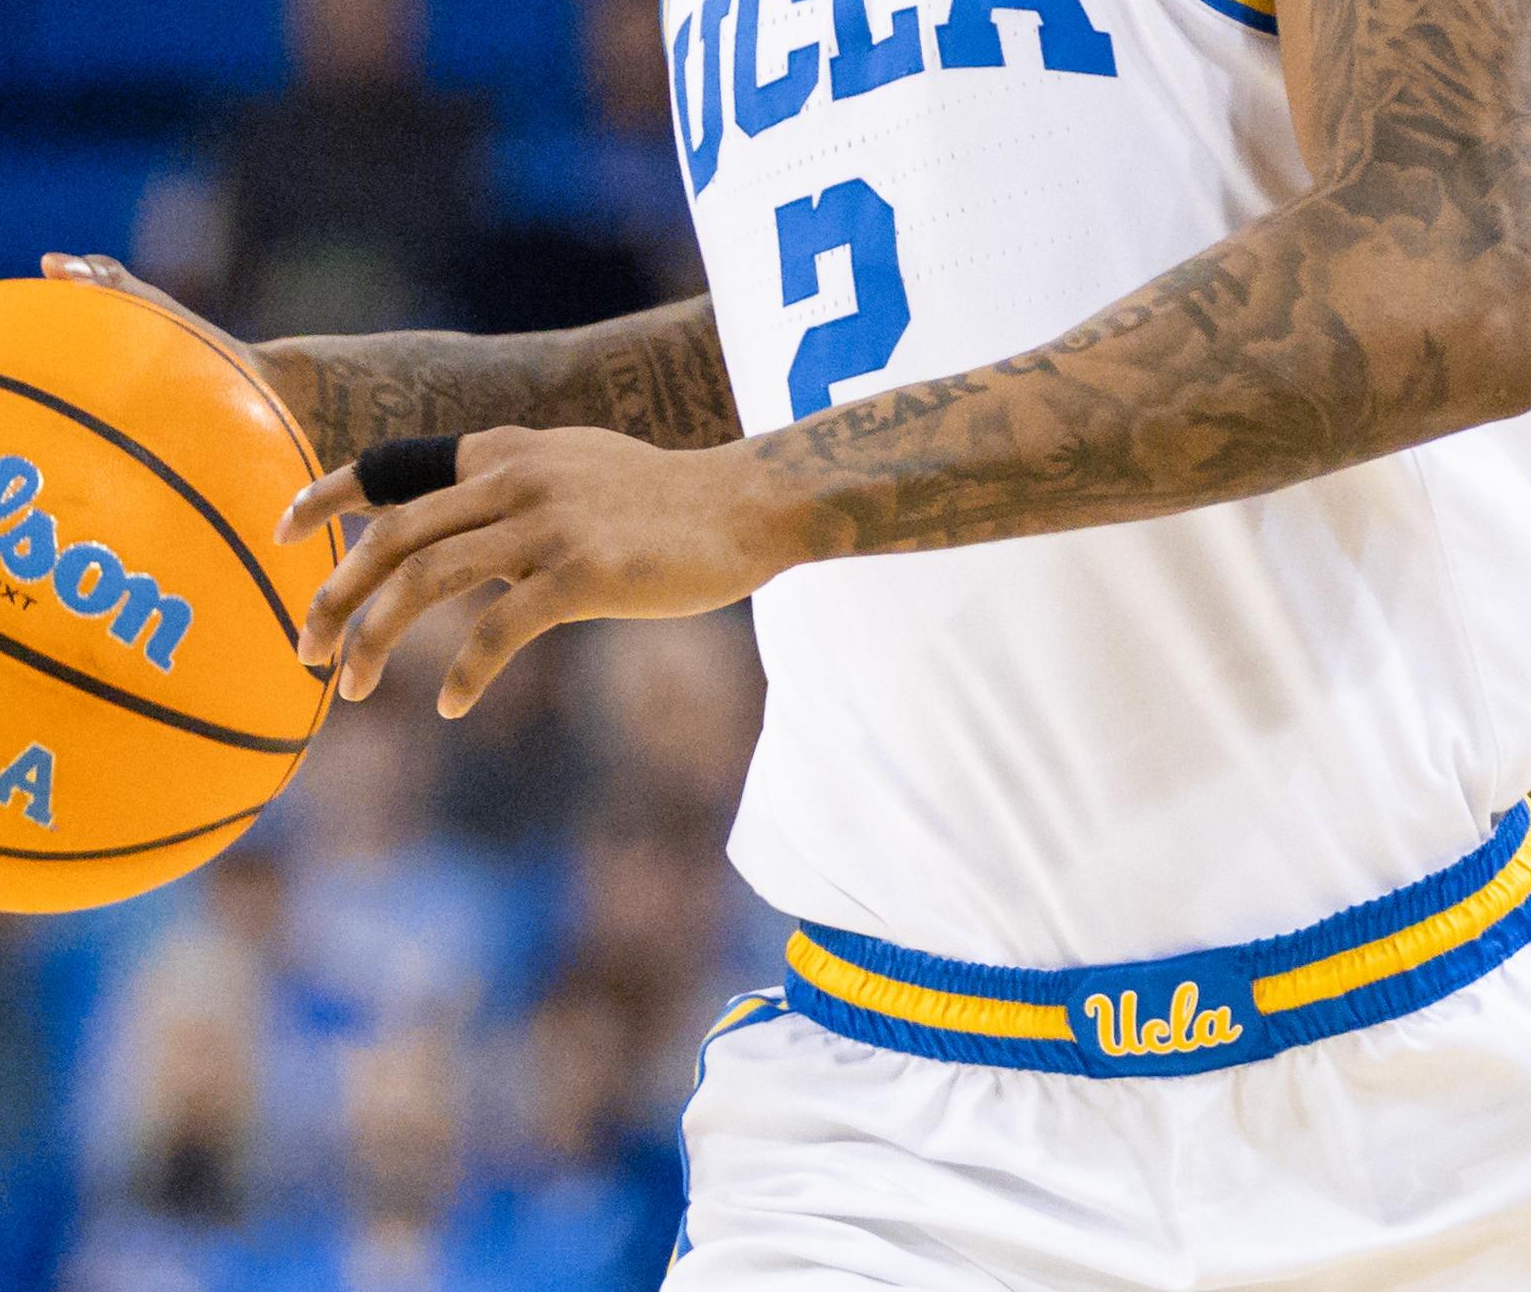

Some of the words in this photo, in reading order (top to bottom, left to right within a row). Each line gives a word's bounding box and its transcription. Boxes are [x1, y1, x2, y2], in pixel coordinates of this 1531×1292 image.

[774, 177, 911, 422] 2
[804, 374, 987, 461] FEAR
[1084, 981, 1243, 1056] Ucla
